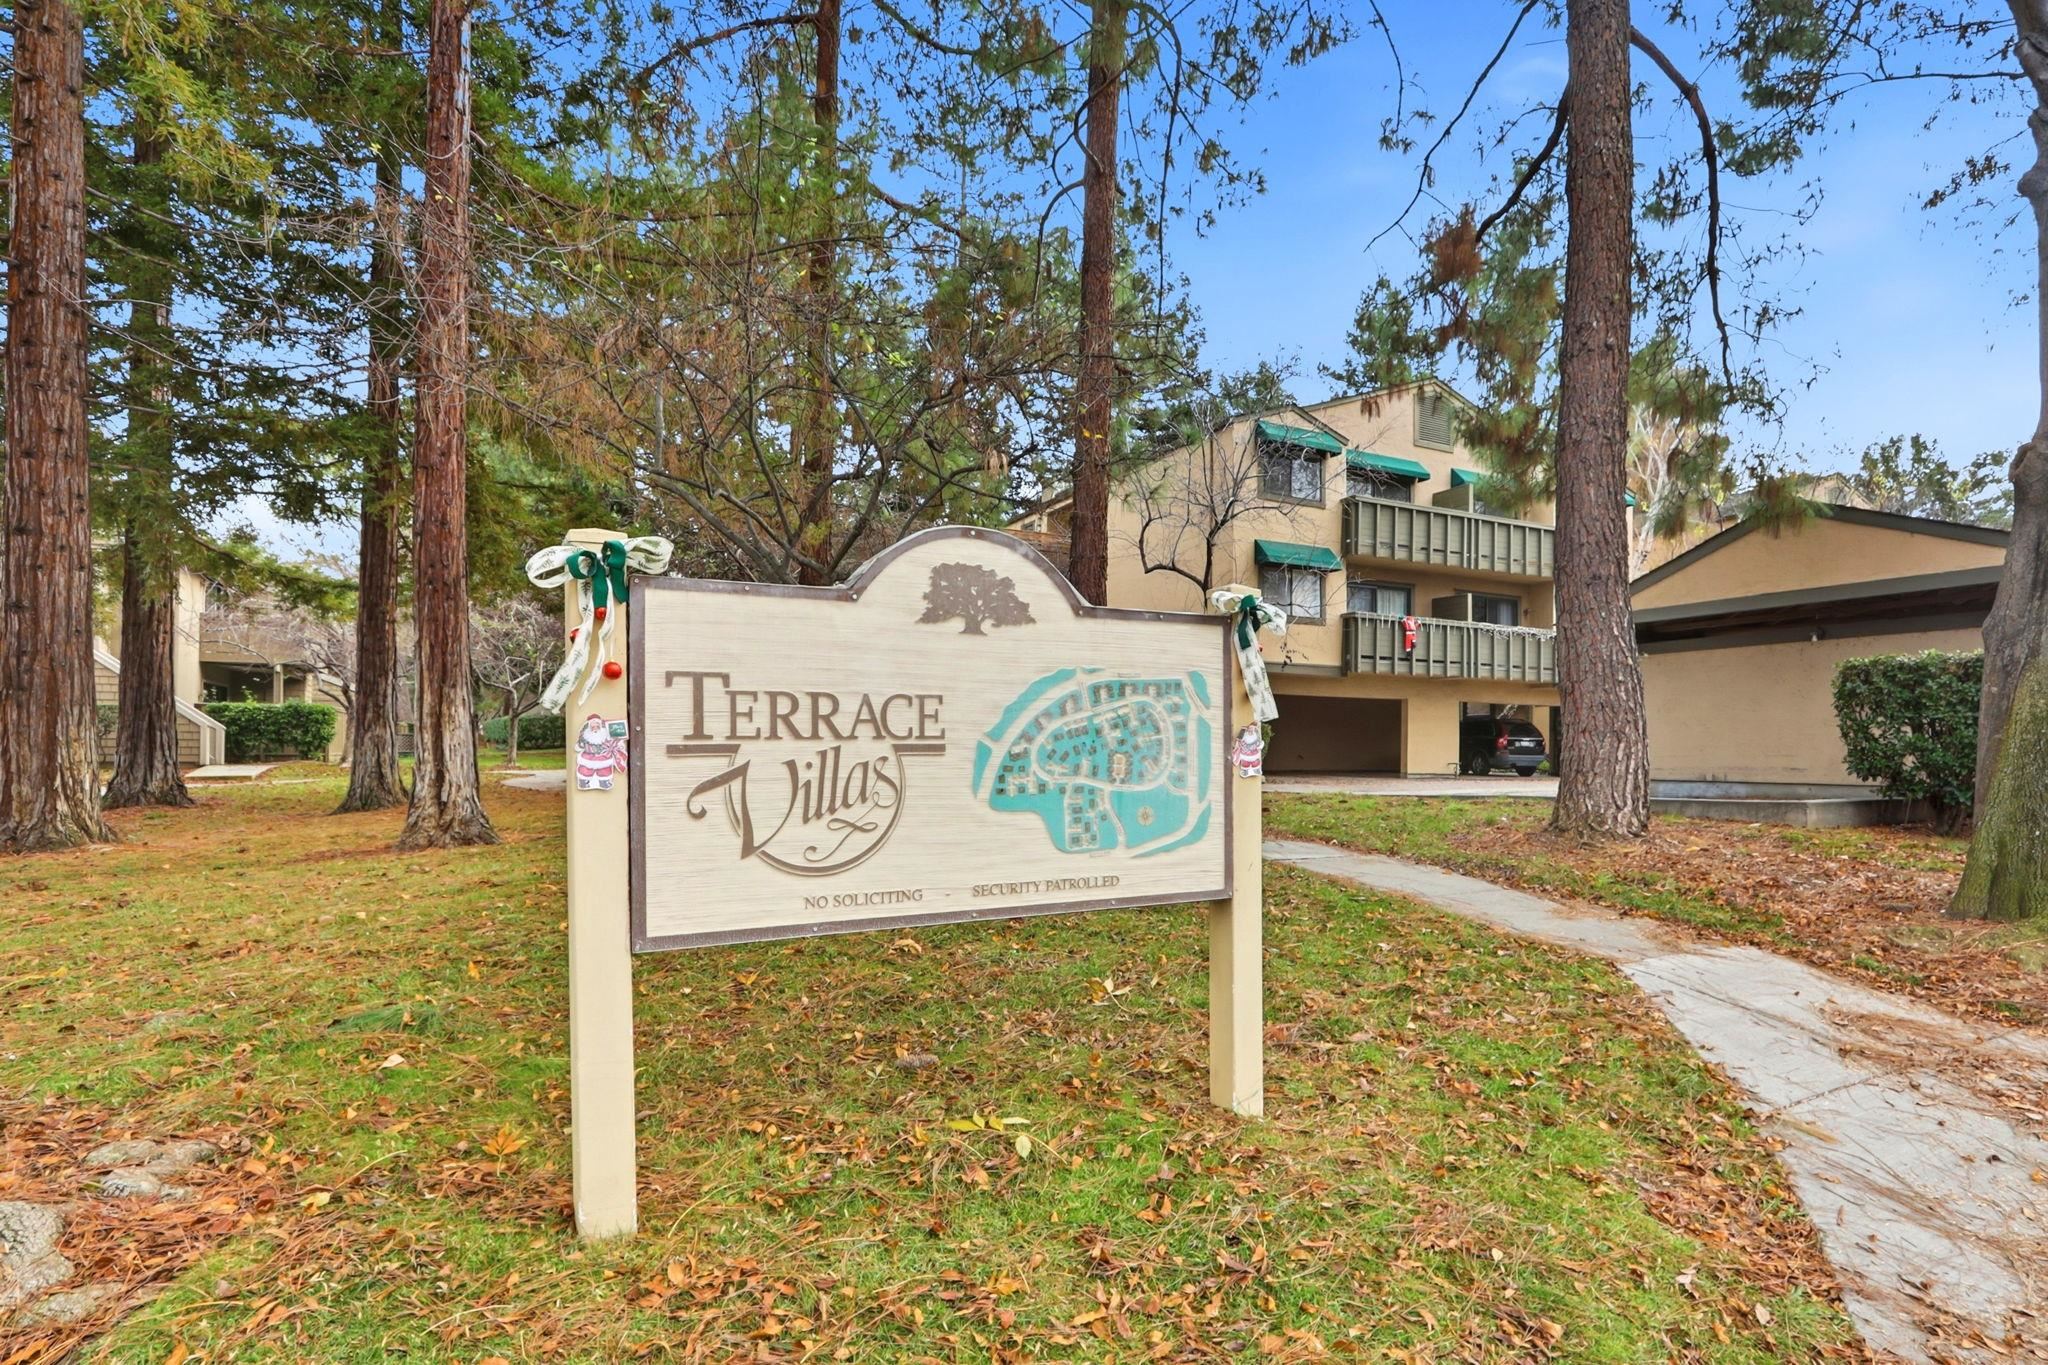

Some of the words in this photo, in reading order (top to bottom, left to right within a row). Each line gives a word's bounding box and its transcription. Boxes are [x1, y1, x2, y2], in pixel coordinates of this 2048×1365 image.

[664, 670, 946, 740] TERRACE
[686, 744, 900, 862] Villas
[804, 895, 829, 909] NO
[833, 889, 923, 906] SOLICITING
[972, 880, 1041, 898] SECURITY
[1046, 875, 1120, 892] PATROLLED
